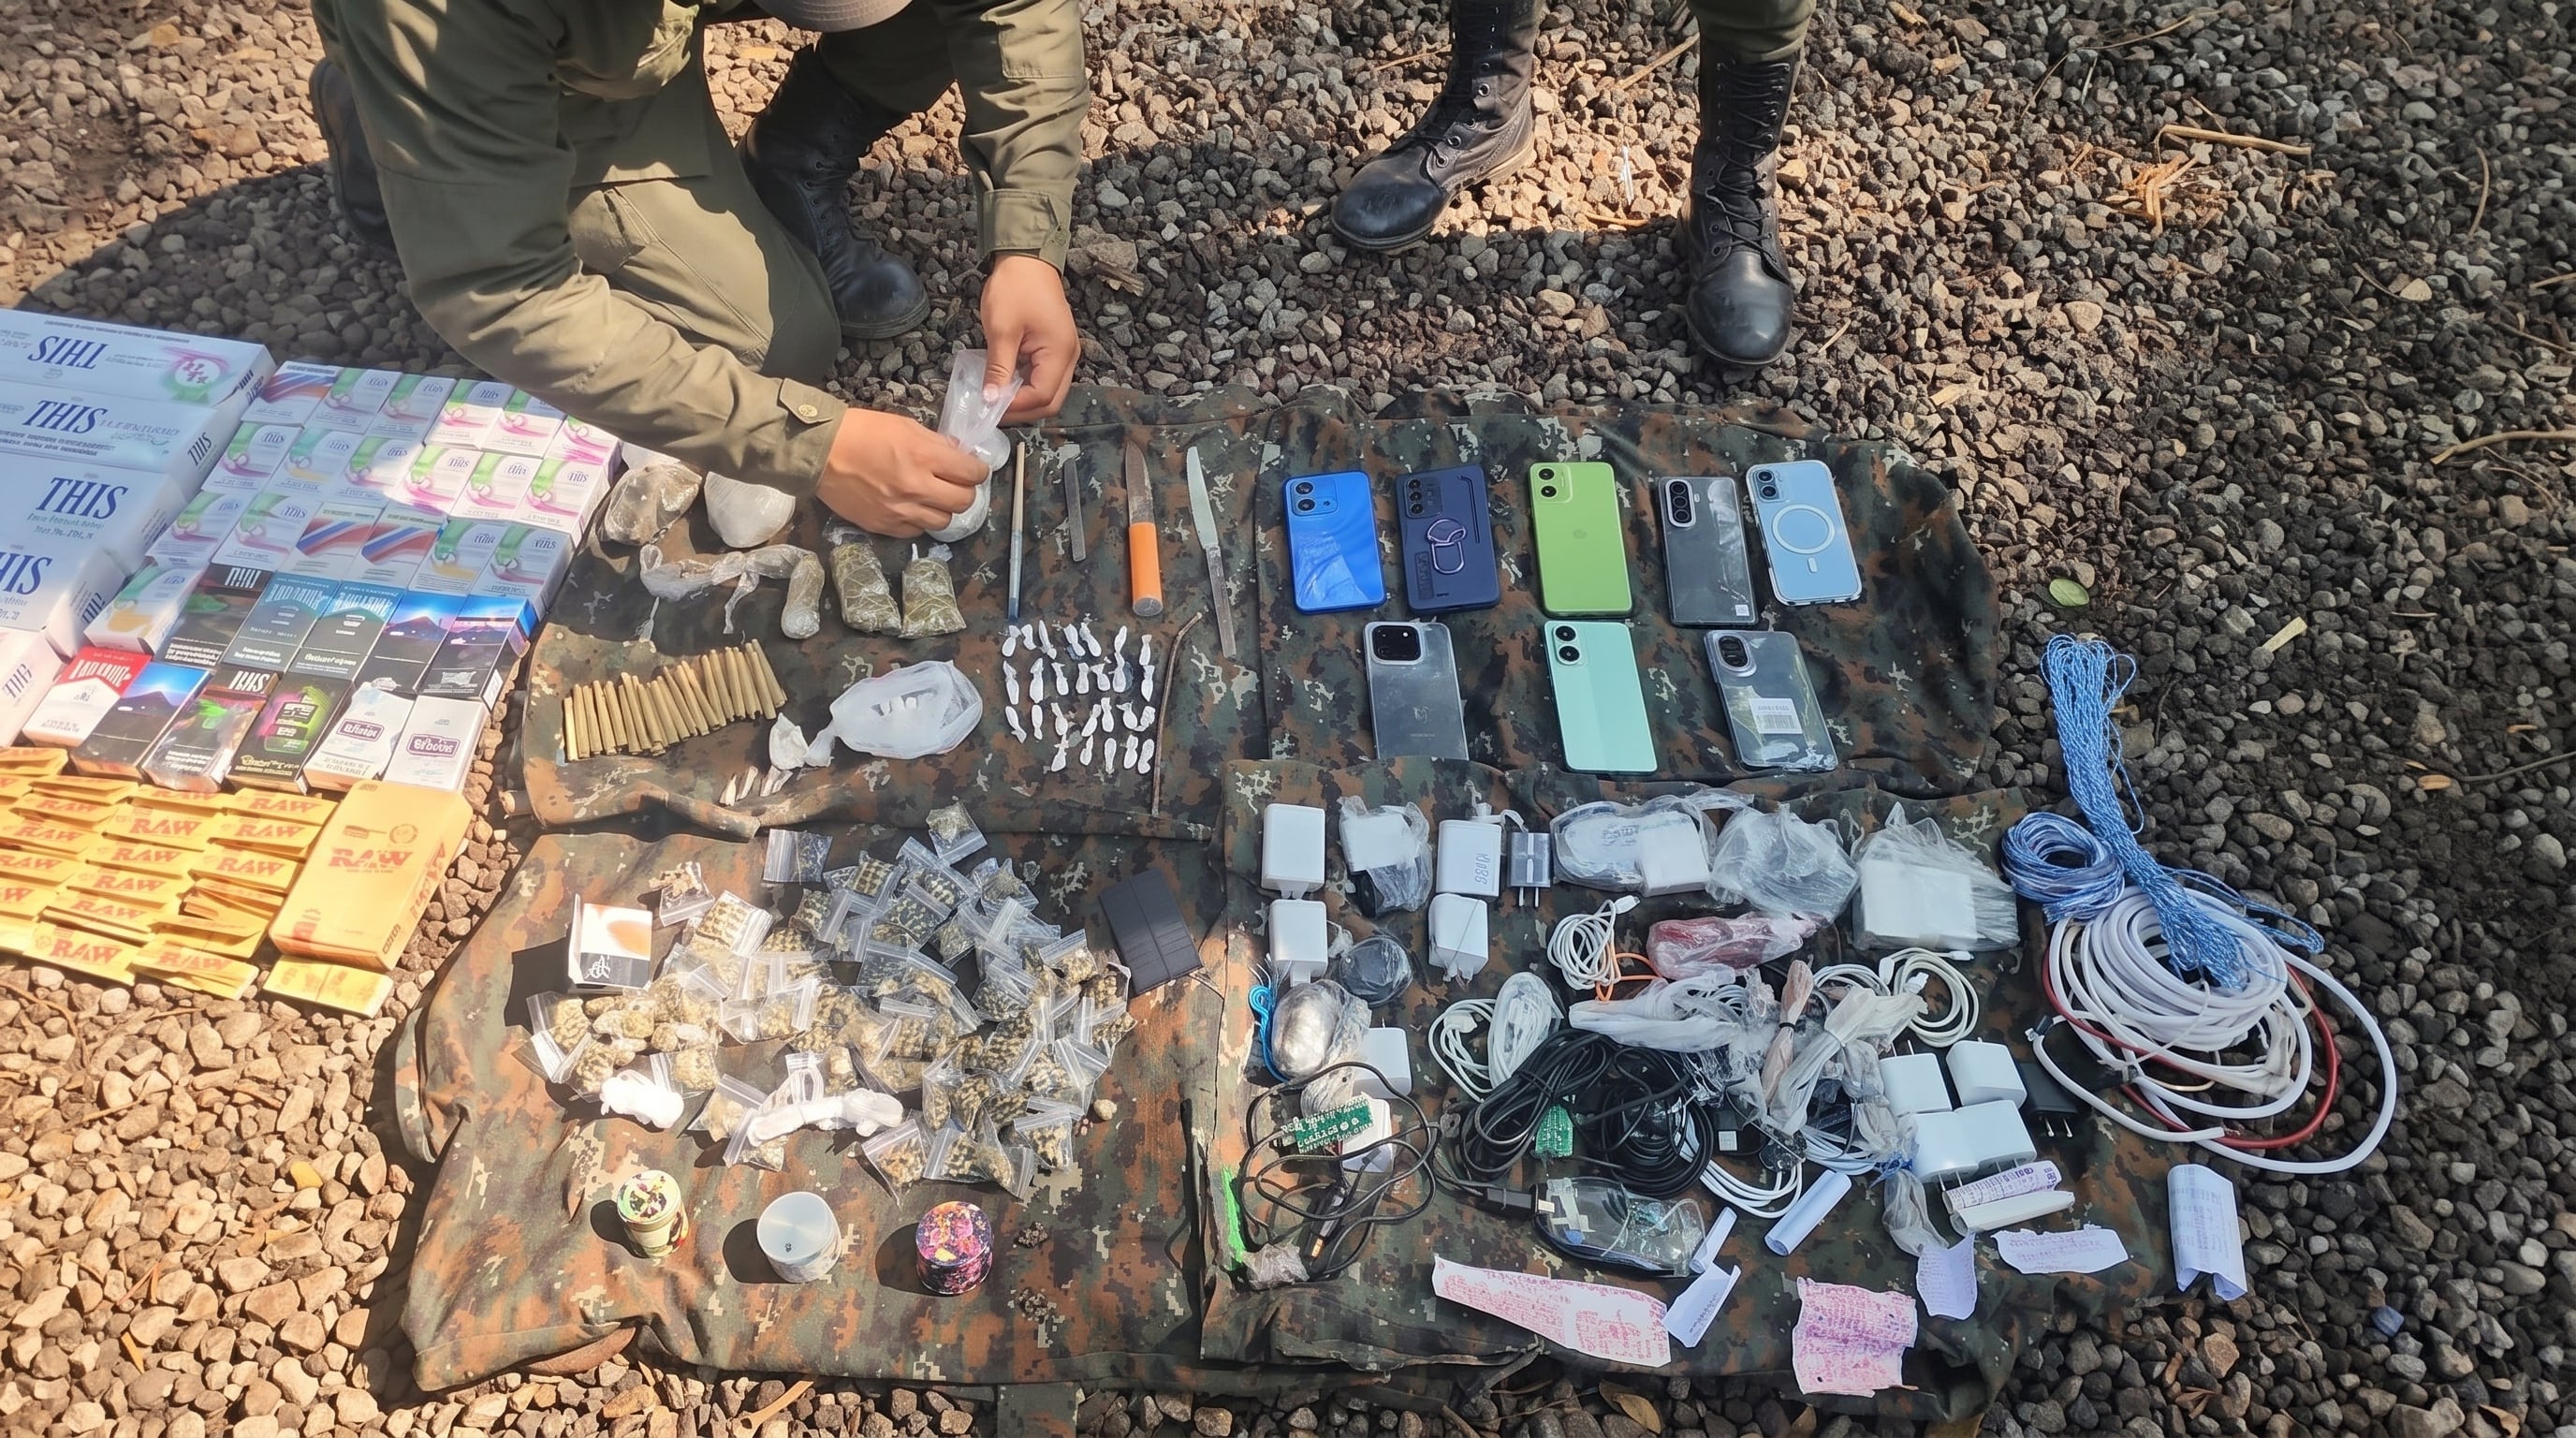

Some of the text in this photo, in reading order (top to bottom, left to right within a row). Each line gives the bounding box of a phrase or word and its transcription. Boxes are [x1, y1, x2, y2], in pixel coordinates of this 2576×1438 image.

[22, 400, 109, 433] THIS
[36, 477, 128, 520] THIS
[0, 551, 52, 595] HIS
[248, 796, 323, 814] RAW
[13, 826, 82, 842] RAW
[130, 818, 203, 836] RAW
[234, 821, 305, 838] RAW
[111, 846, 183, 862] RAW
[328, 847, 414, 869] RAW
[215, 856, 285, 875] RAW
[94, 874, 167, 892] RAW
[70, 899, 147, 919] RAW
[50, 939, 122, 964] RAW
